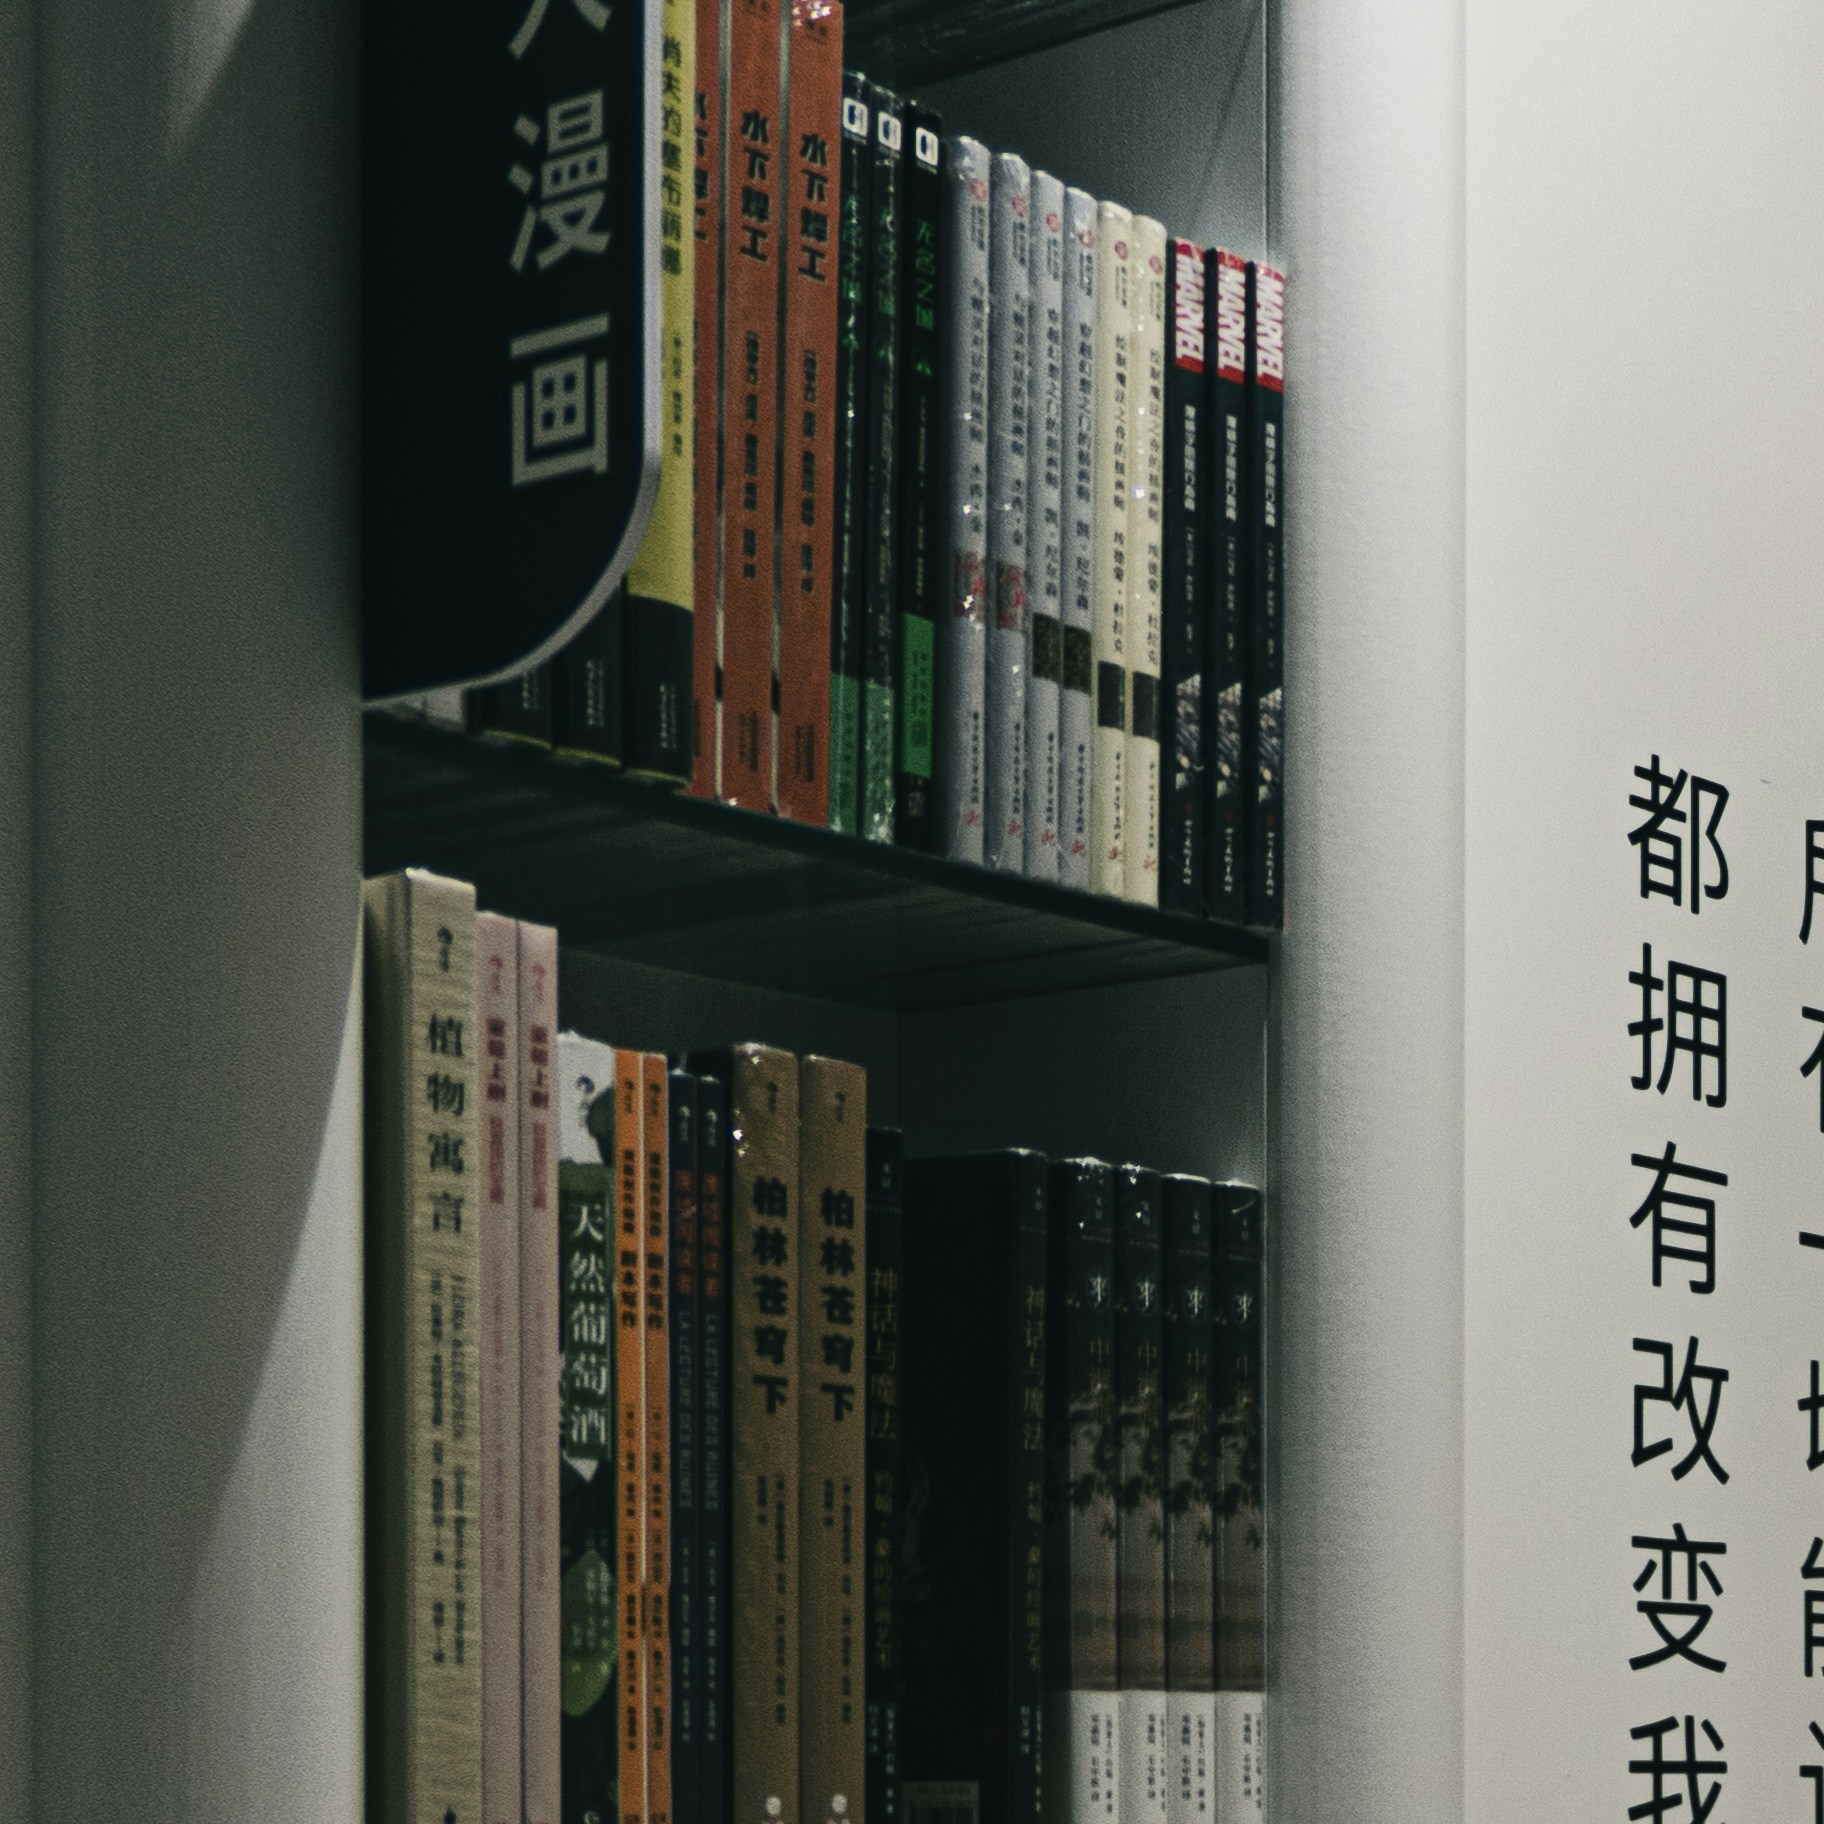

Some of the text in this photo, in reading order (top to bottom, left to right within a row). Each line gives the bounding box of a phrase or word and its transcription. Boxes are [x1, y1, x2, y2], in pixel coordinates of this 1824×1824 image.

[1175, 253, 1205, 364] MARVEL
[1217, 262, 1247, 373] MARVEL
[1256, 275, 1285, 382] MARVEL
